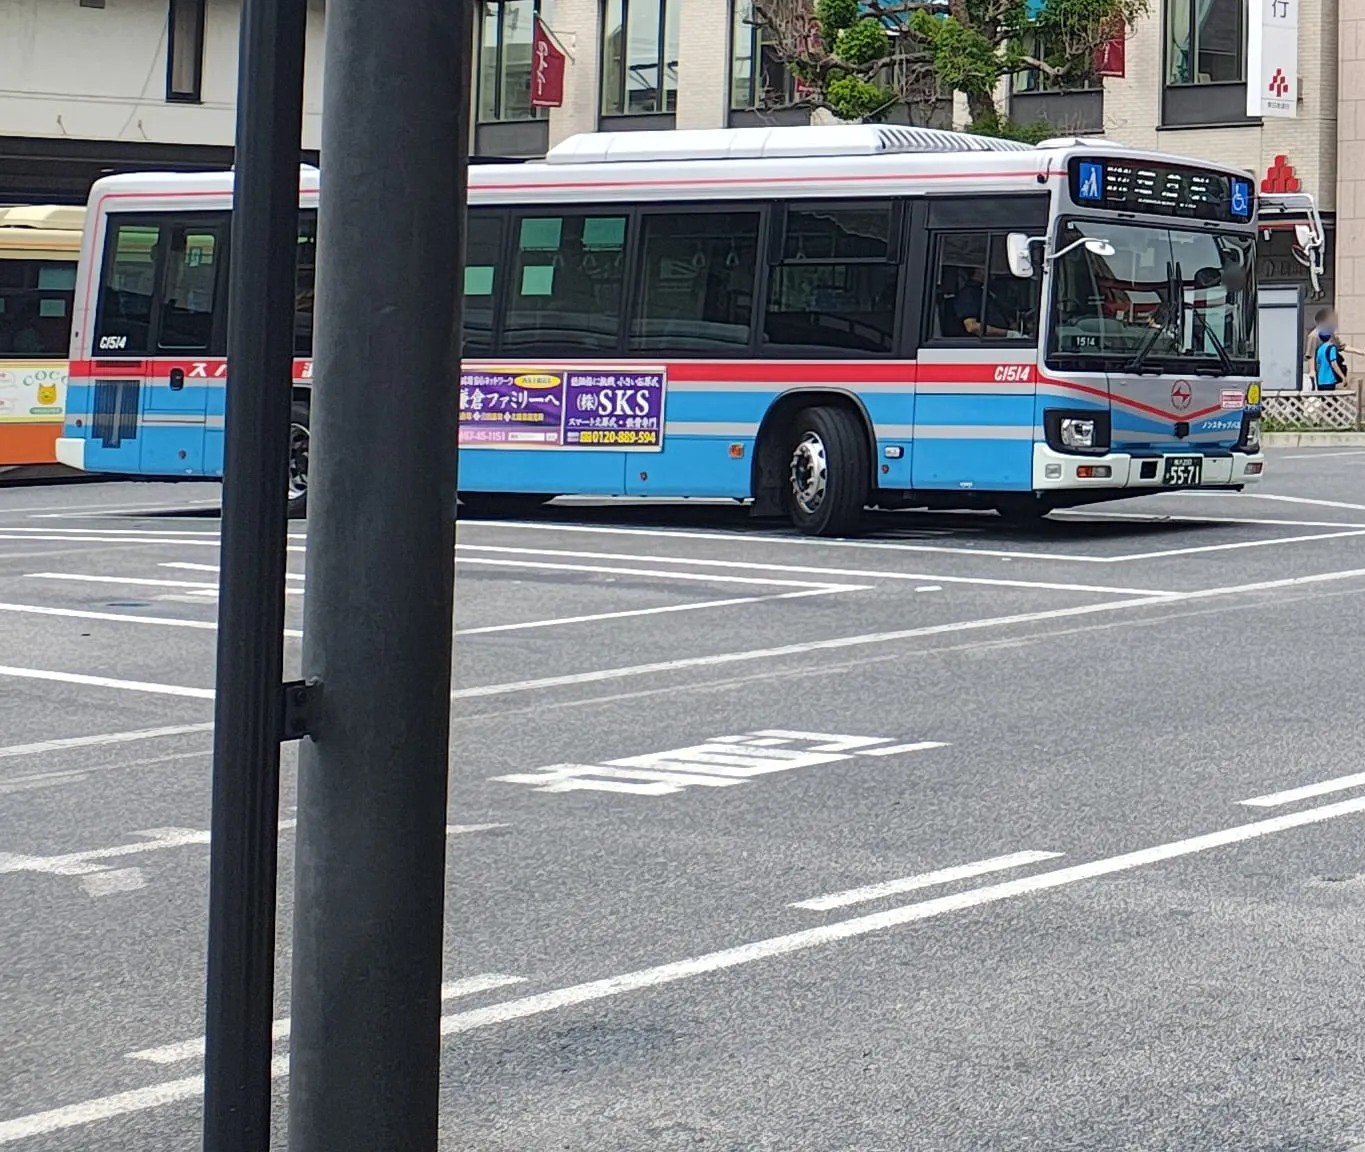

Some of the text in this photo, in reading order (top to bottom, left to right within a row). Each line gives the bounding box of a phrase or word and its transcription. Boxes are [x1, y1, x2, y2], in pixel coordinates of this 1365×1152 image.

[99, 336, 127, 349] C1514
[1076, 336, 1096, 347] 1514
[994, 365, 1031, 382] C1514
[1170, 466, 1200, 486] 55-71
